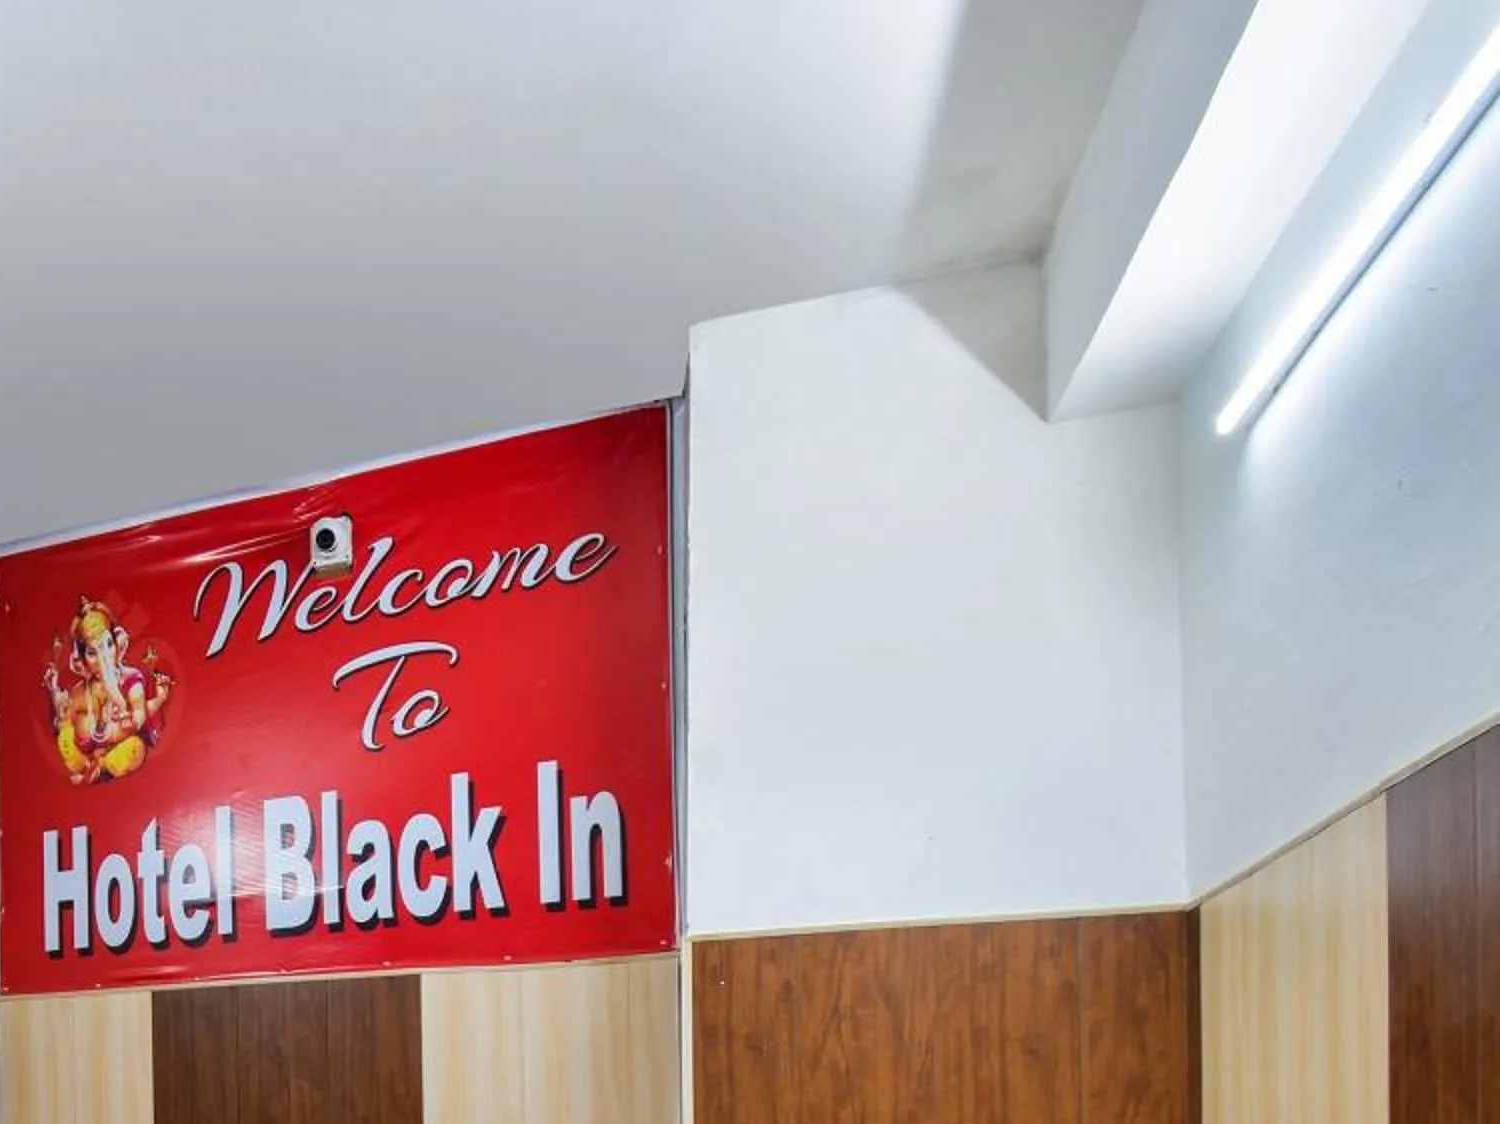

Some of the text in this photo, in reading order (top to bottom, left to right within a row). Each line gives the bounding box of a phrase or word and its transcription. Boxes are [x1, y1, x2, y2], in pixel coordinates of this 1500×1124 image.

[194, 532, 618, 659] Welcome
[332, 641, 460, 750] To
[43, 760, 626, 958] Hotel Black In
